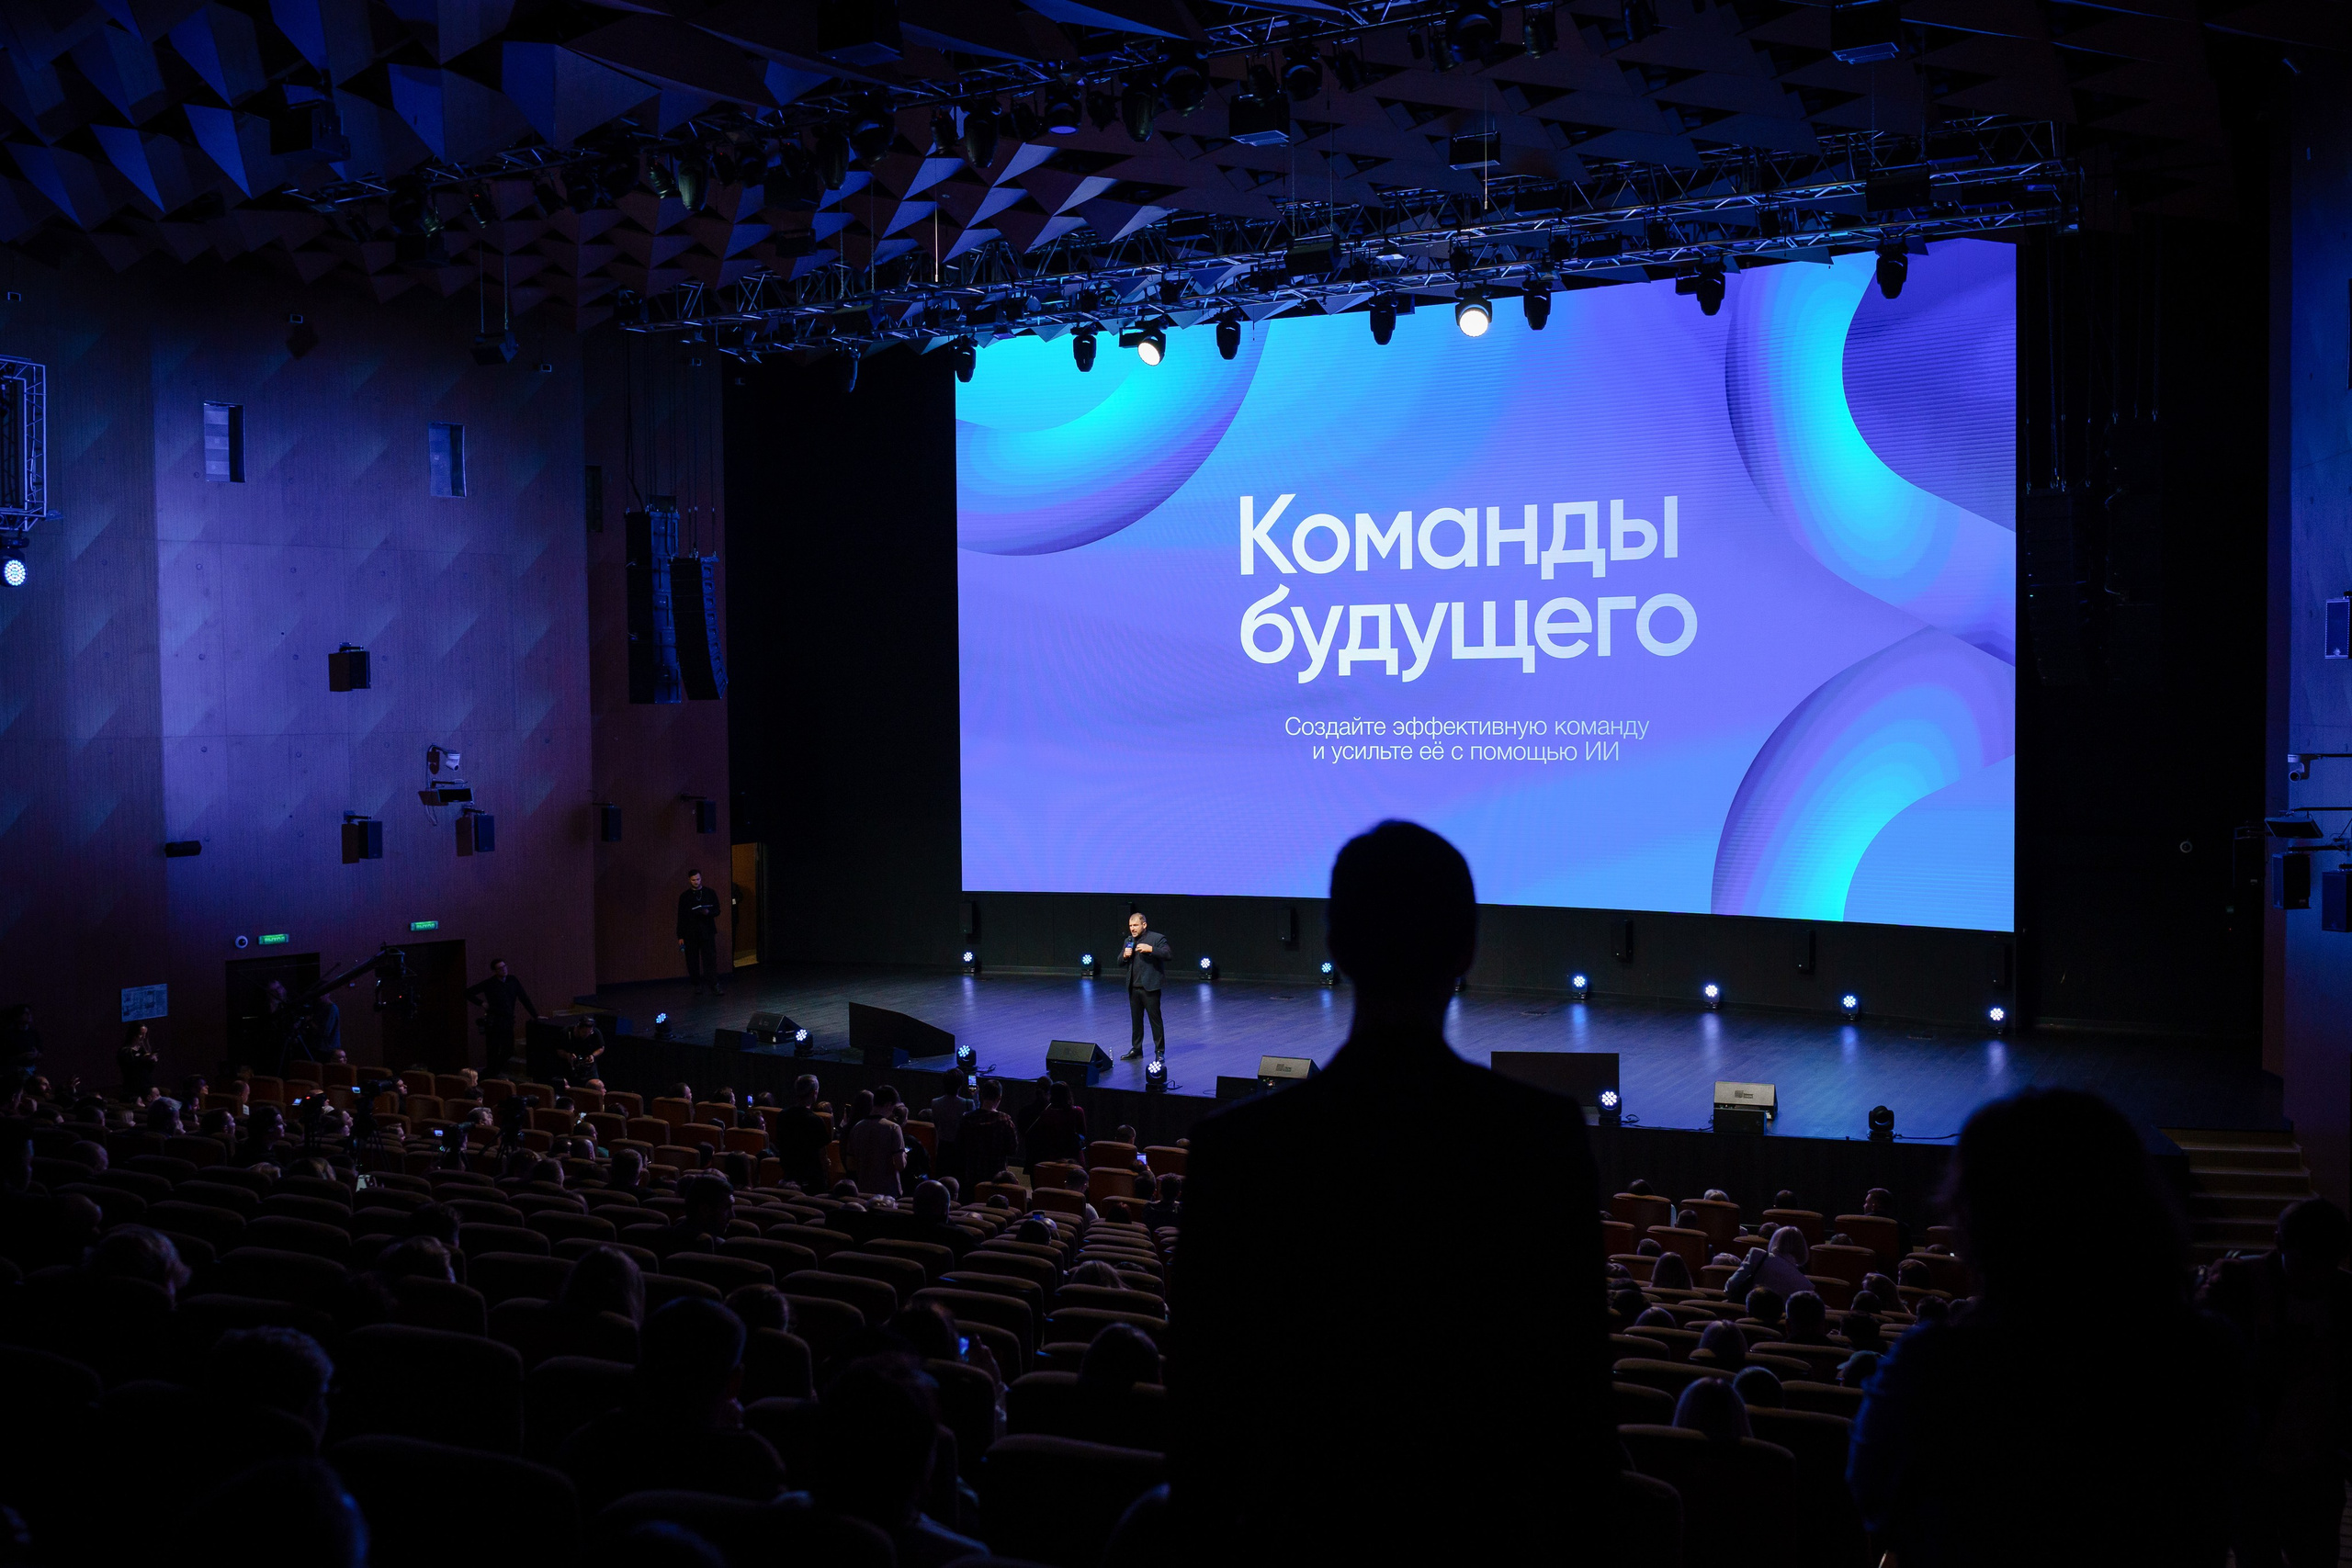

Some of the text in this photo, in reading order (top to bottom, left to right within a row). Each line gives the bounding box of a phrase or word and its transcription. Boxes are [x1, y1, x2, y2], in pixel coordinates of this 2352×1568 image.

[1240, 494, 1679, 580] Команды
[1240, 583, 1698, 683] будущего
[1285, 716, 1650, 740] Создайте эффективную команду
[1313, 740, 1620, 765] и усильте её с помощью ИИ
